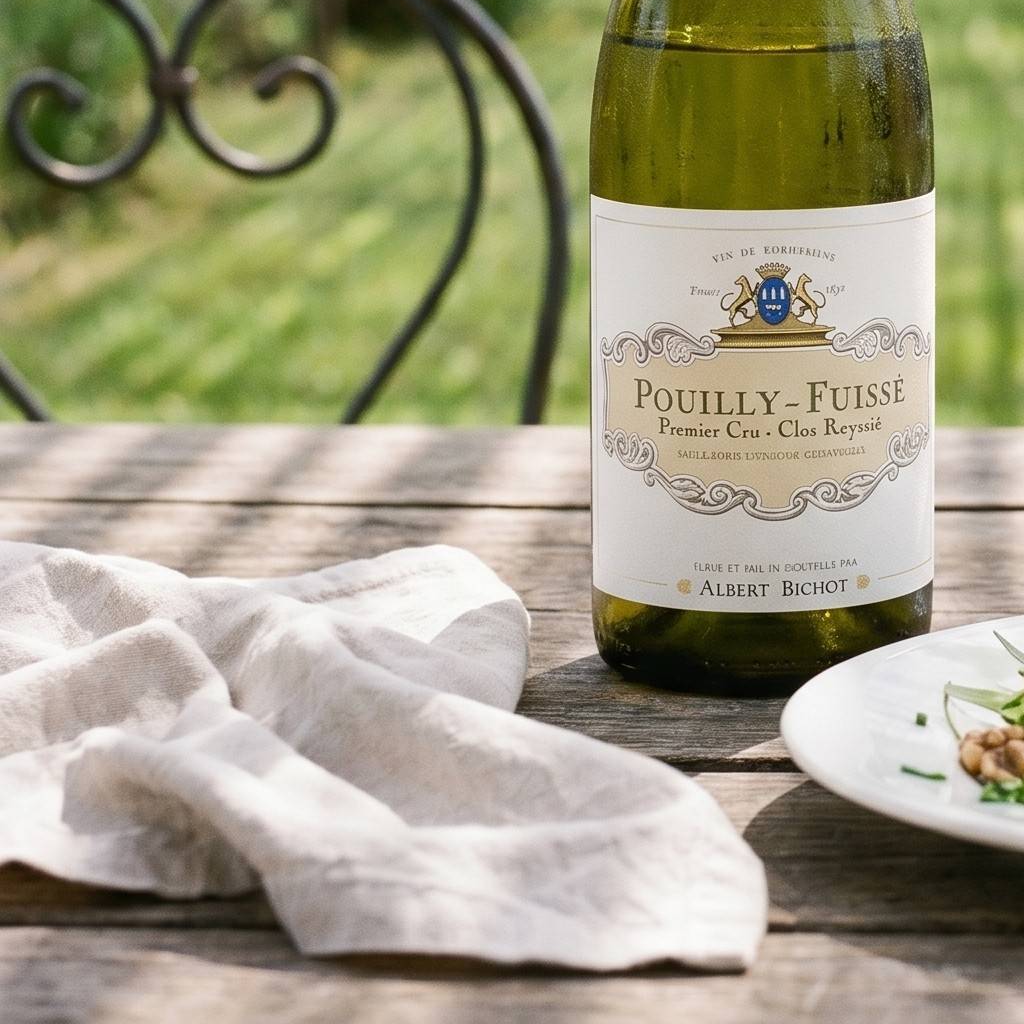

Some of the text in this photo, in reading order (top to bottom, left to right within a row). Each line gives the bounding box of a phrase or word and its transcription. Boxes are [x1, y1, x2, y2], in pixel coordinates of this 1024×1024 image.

[740, 247, 756, 257] DE
[658, 417, 883, 441] Premier Cru Clos Reyssié
[728, 564, 740, 573] ET
[768, 564, 780, 573] IN
[699, 579, 848, 597] ALBERT BICHOT
